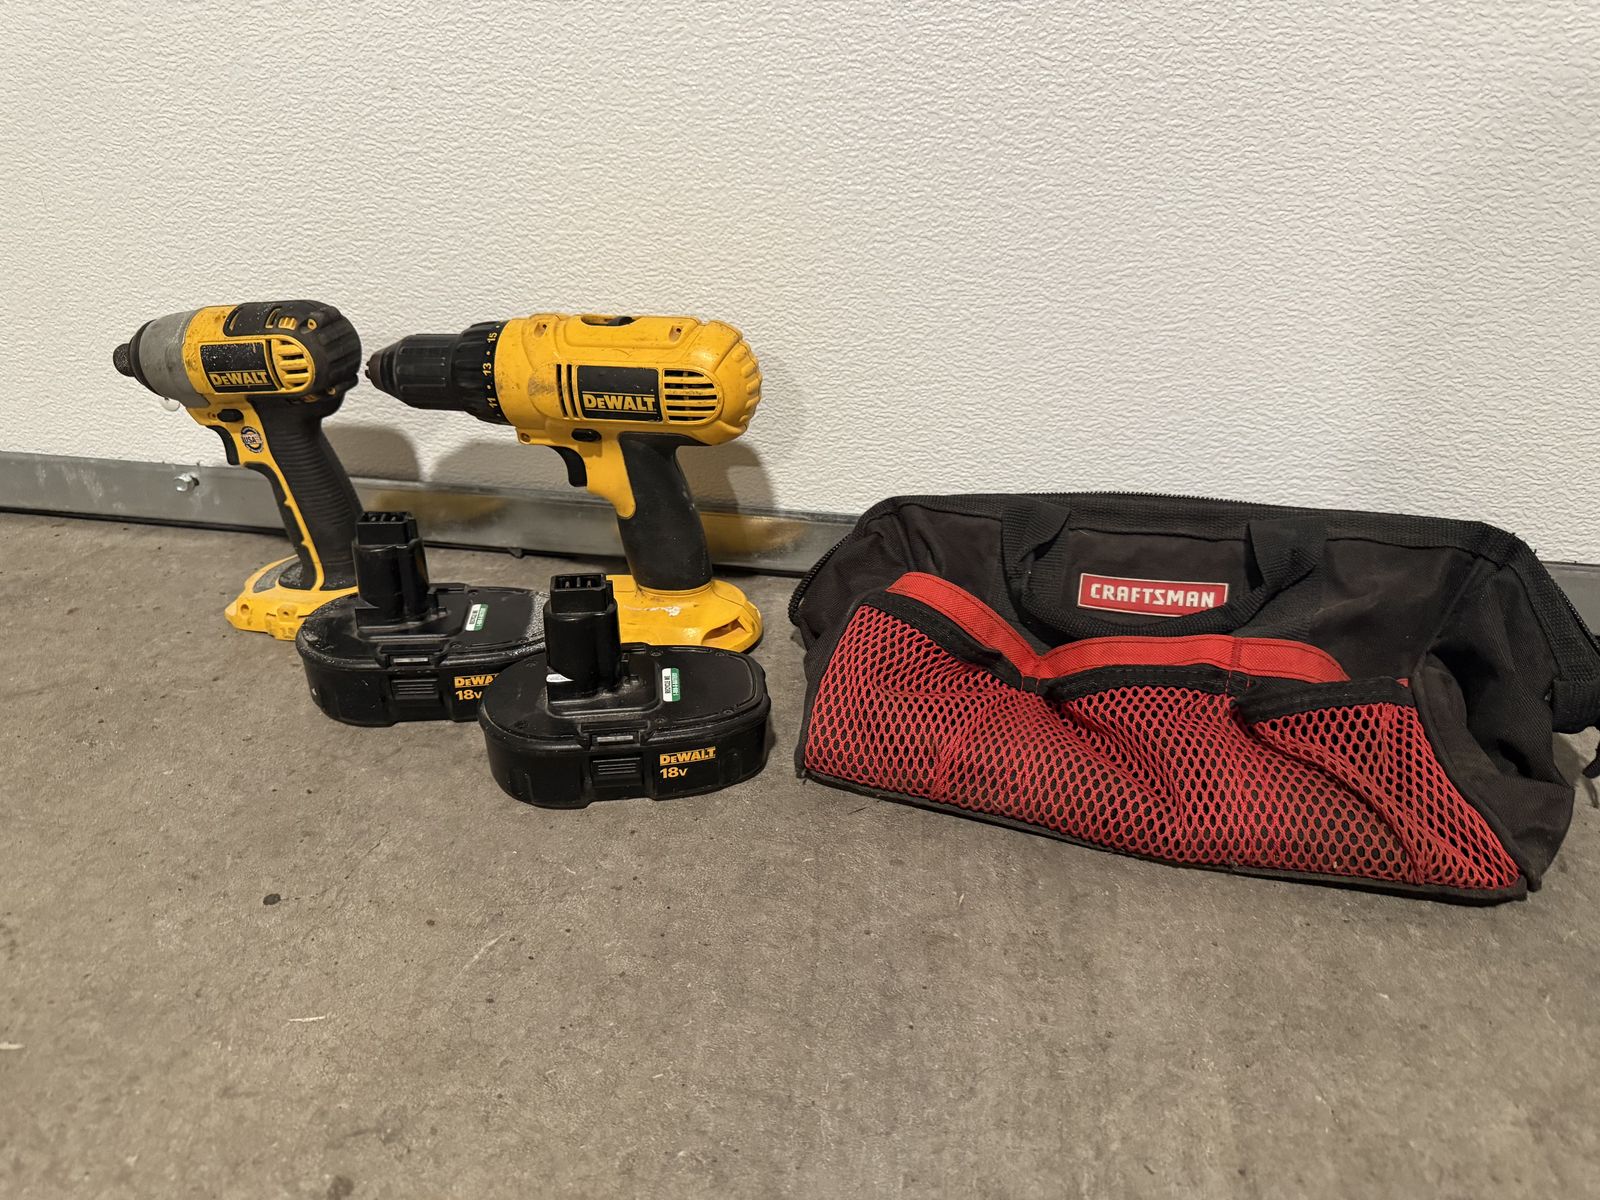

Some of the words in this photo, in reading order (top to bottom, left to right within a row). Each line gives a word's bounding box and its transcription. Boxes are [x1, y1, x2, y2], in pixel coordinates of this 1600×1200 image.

[487, 332, 498, 343] 15
[482, 362, 492, 376] 13
[487, 397, 498, 409] 11
[1090, 583, 1216, 608] CRAFTSMAN
